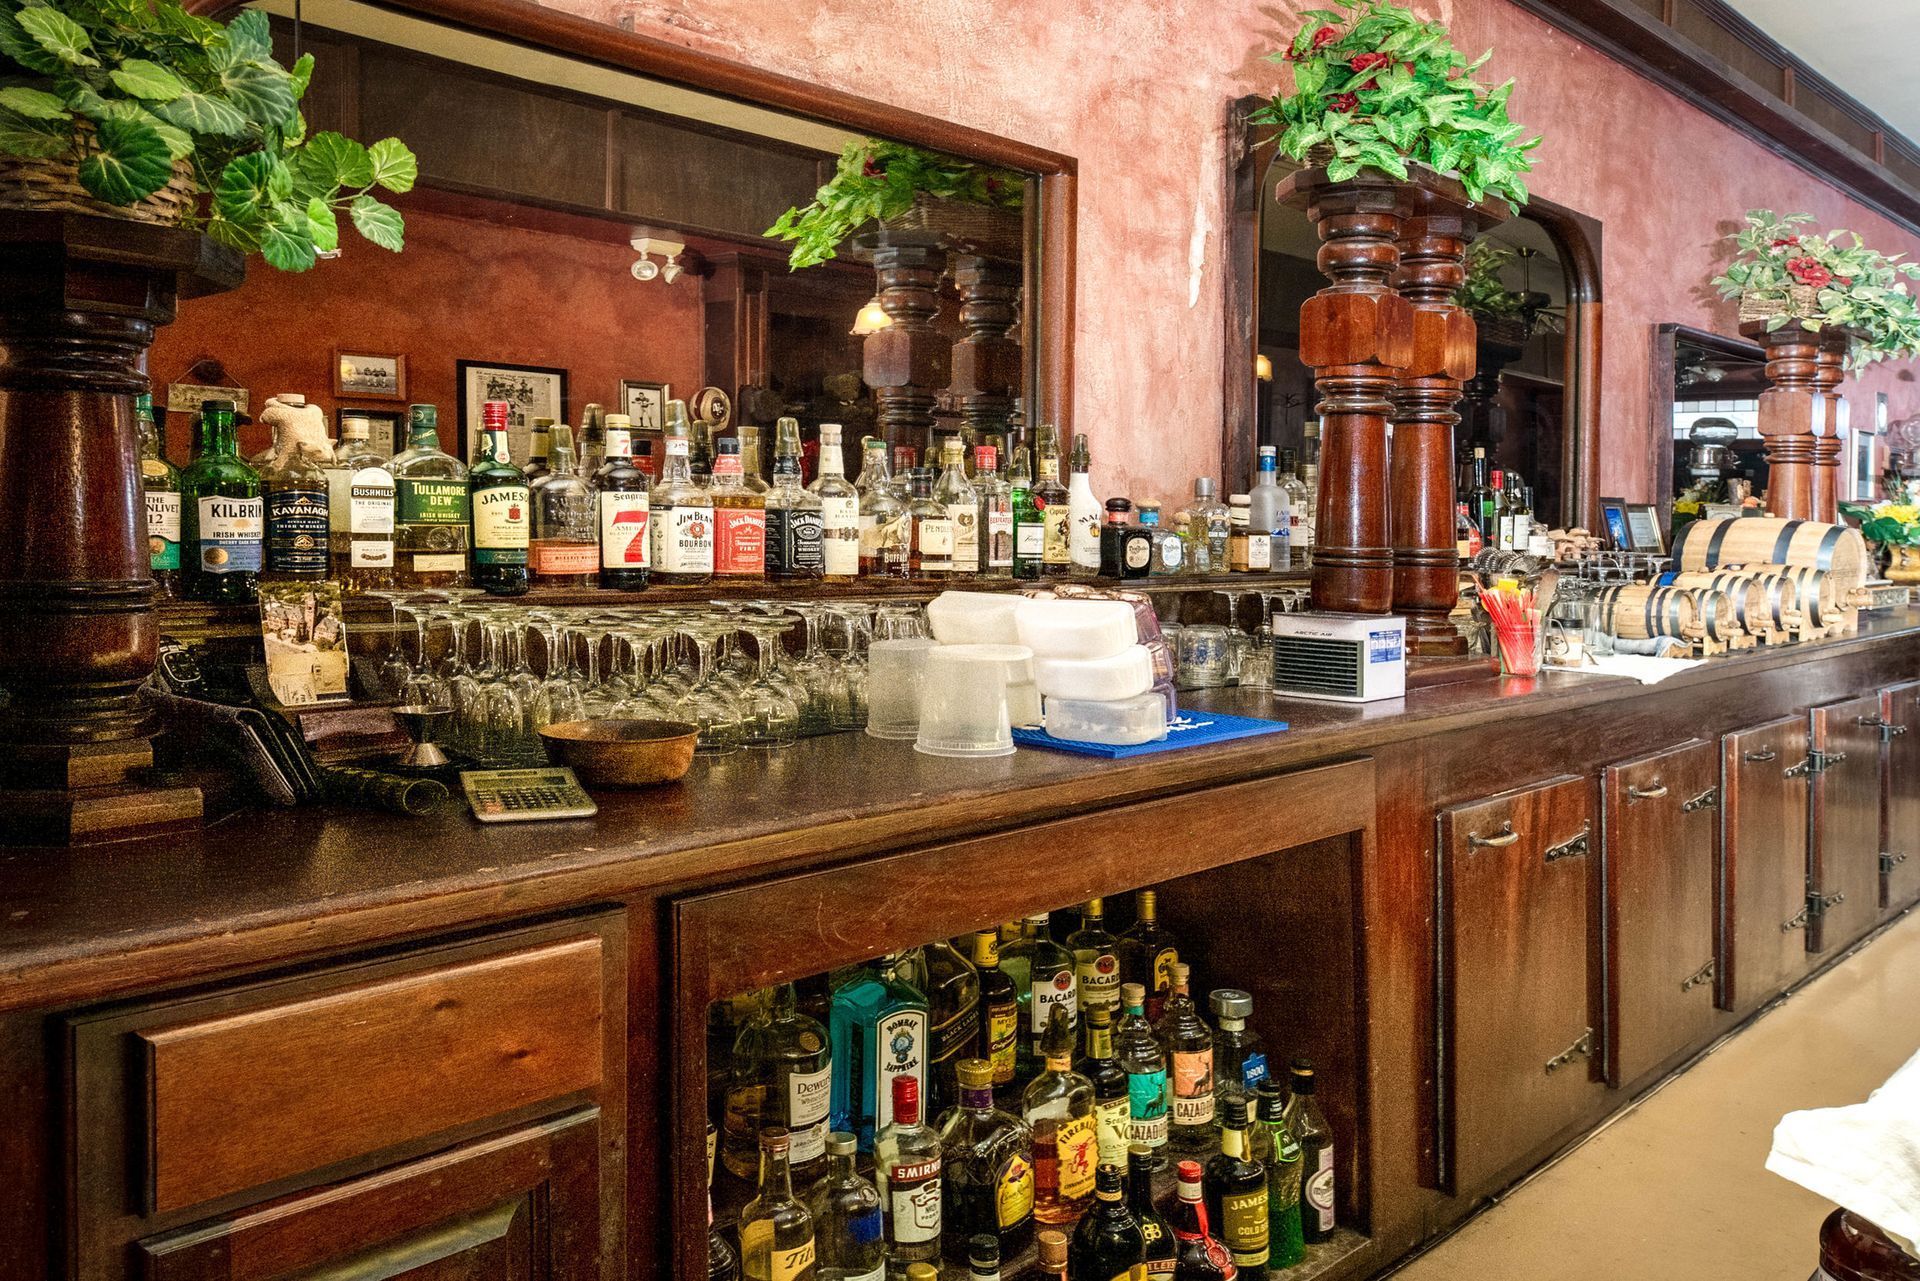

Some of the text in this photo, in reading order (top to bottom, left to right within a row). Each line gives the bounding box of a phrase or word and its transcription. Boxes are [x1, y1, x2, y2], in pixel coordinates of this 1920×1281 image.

[353, 487, 394, 497] BUSHMILLS
[411, 482, 466, 496] TULLAMORE
[146, 496, 165, 504] THE
[430, 495, 452, 506] DEW
[272, 506, 329, 517] KAVANAGH
[148, 514, 164, 524] 12
[676, 514, 693, 527] JIM
[729, 518, 745, 529] JACK
[789, 517, 805, 529] JACK
[1078, 513, 1101, 525] MAL
[611, 510, 649, 562] 7
[679, 539, 712, 548] BOURBON
[886, 1018, 919, 1035] BOMBAY
[883, 1056, 920, 1073] SAPPHIRE
